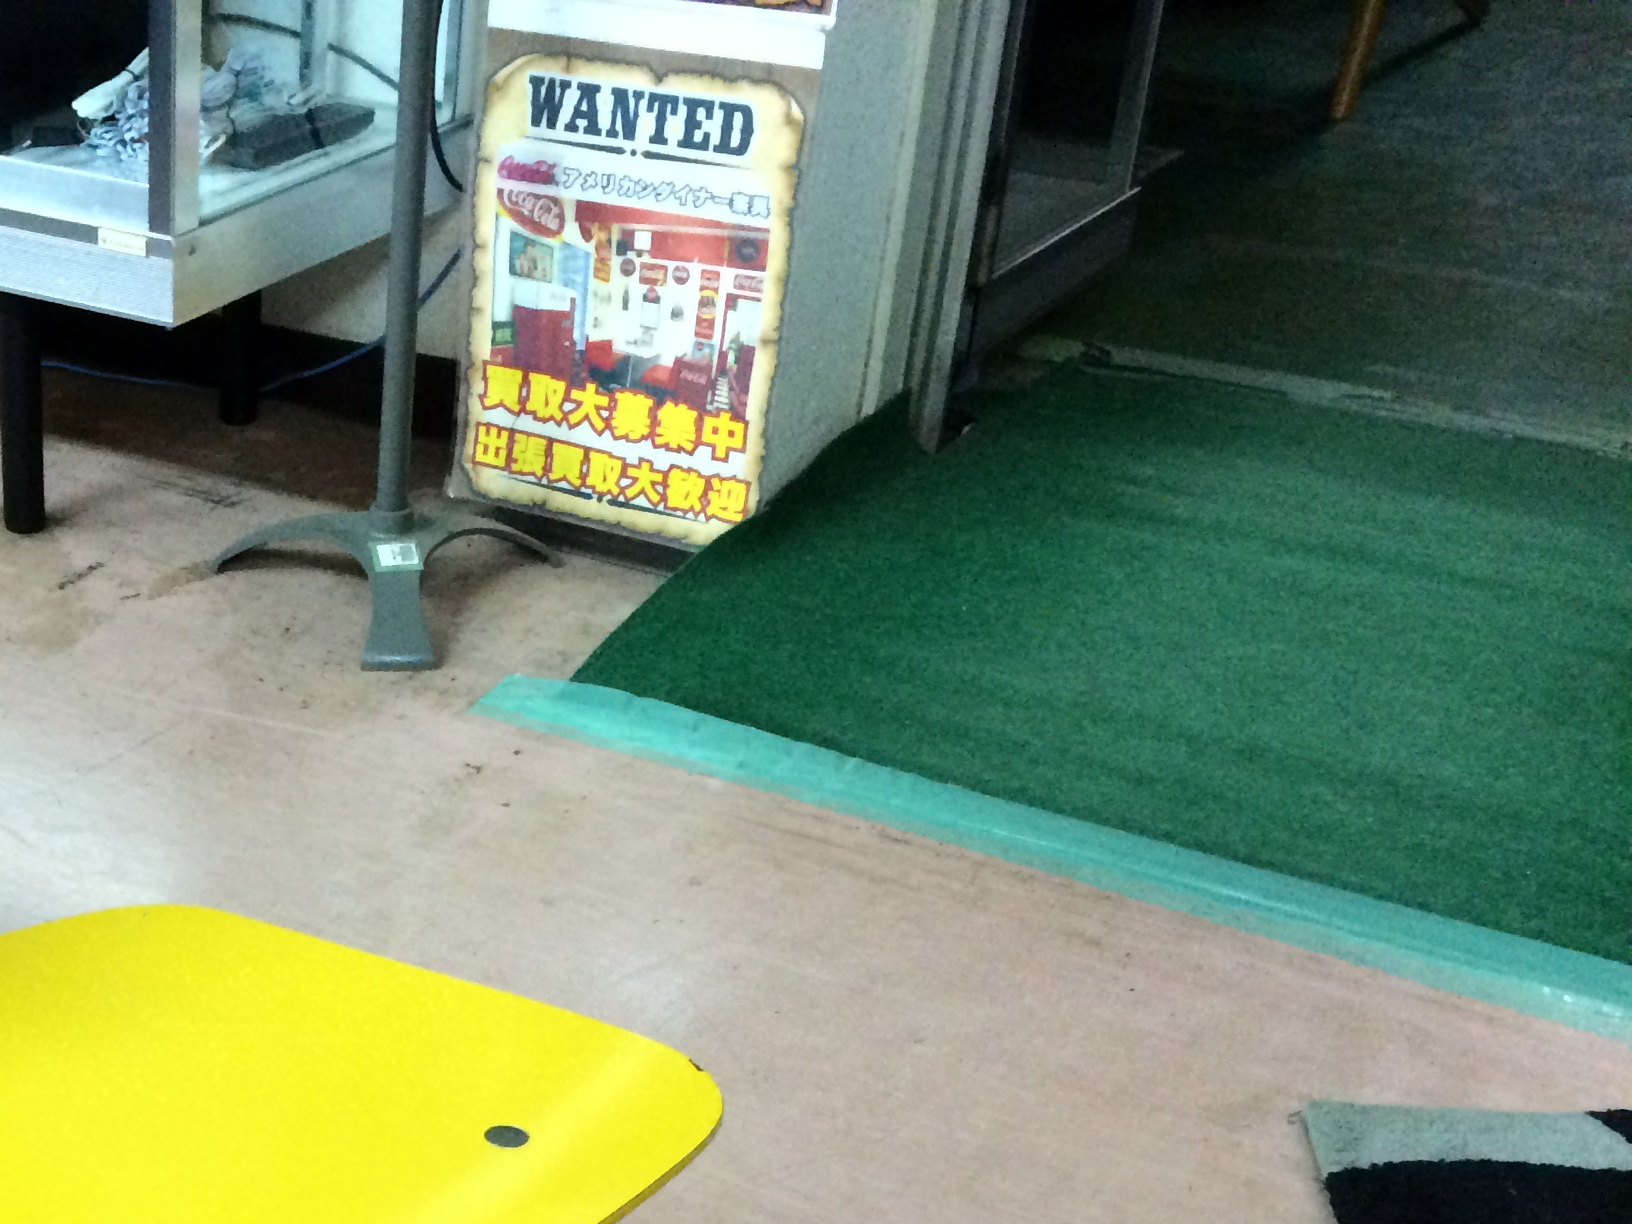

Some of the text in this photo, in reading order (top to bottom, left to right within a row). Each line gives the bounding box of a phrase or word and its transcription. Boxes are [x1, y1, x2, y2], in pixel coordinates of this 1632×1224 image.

[528, 74, 755, 157] WANTED
[480, 361, 747, 461] 買取大募集中
[474, 423, 749, 521] 出張買取大歓迎
